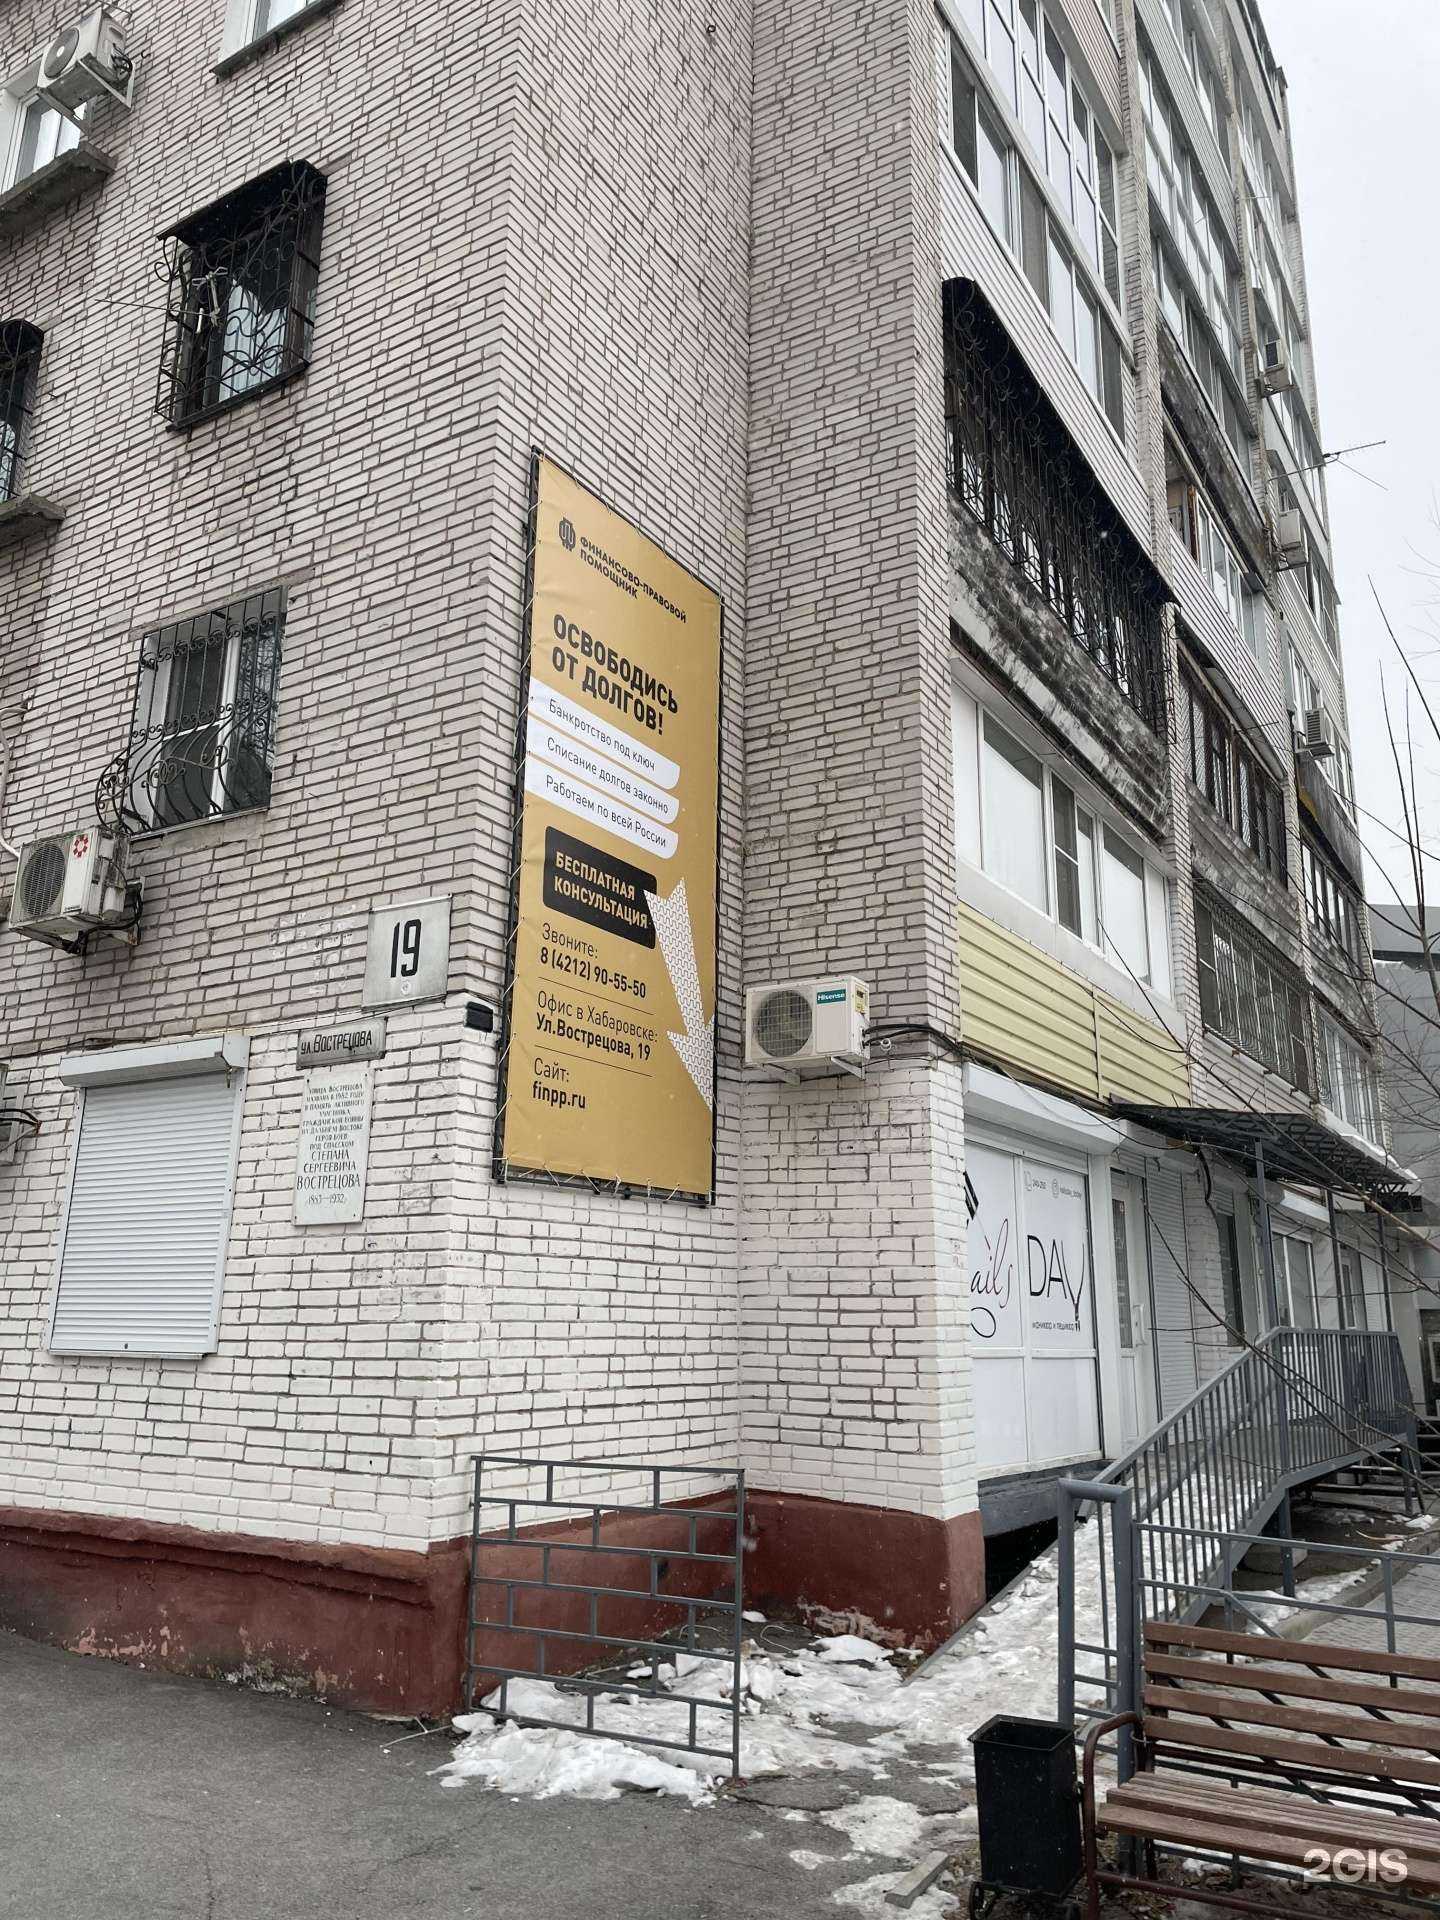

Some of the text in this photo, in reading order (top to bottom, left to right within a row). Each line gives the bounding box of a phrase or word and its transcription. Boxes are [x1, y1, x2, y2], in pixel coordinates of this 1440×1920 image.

[580, 549, 638, 600] ПОМОЩНИК
[580, 536, 687, 623] ФИНАНСОВО-ПРАВОВОЙ
[552, 646, 663, 735] ОТ ДОЛГОВ!
[553, 614, 678, 714] ОСВОБОДИСЬ
[549, 698, 655, 772] Банкротство под ключ
[547, 737, 669, 814] Списание долгов законно
[546, 775, 666, 848] Работаем по всей России
[554, 875, 648, 929] КОНСУЛЬТАЦИЯ
[555, 851, 635, 901] БЕСПЛАТНАЯ
[390, 918, 422, 979] 19
[542, 922, 598, 959] Звоните:
[540, 946, 646, 999] 8 (4212) 90-55-50
[817, 991, 845, 1001] Hisense
[536, 1012, 651, 1061] Ул.Вострецова, 19
[538, 990, 658, 1043] Офис в Хабаровске:
[532, 1080, 586, 1109] finpp.ru
[534, 1057, 570, 1083] Сайт:
[296, 1173, 361, 1190] ВОСТРЕЦОВА
[303, 1160, 356, 1174] СЕРГЕЕВИЧА
[311, 1149, 350, 1161] СТЕПАНА
[1027, 1234, 1085, 1322] DAY
